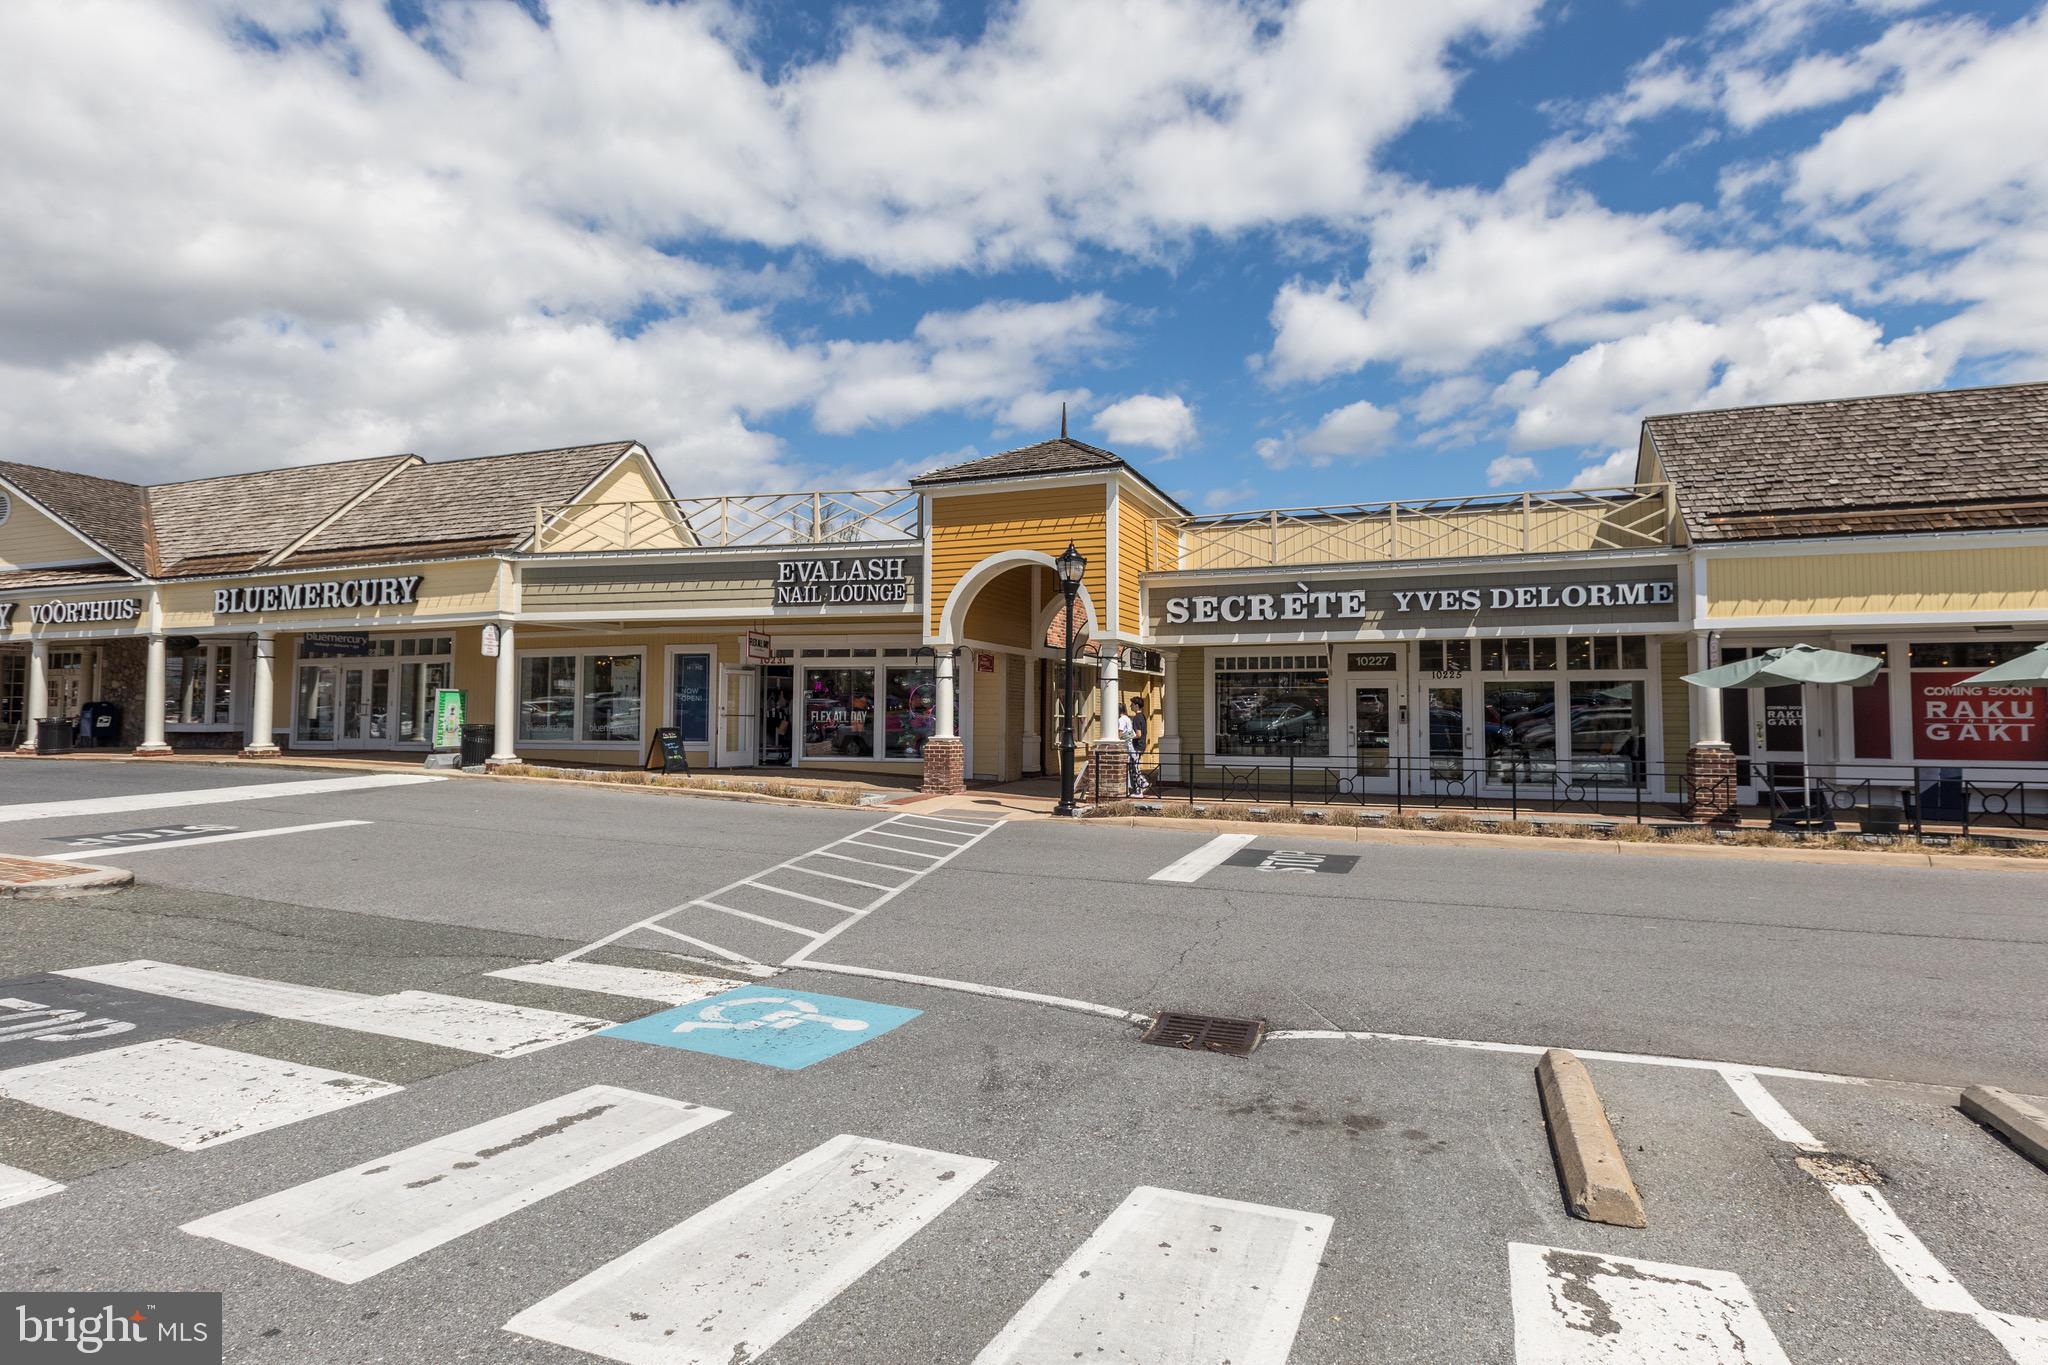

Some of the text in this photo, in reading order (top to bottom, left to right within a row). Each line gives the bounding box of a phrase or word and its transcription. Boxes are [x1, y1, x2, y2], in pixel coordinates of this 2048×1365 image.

[777, 558, 905, 583] EVALASH
[214, 575, 419, 614] BLUEMERCURY
[777, 583, 906, 604] NAIL LOUNGE
[1166, 581, 1366, 624] SECRÈTE
[1393, 582, 1674, 612] YVES DELORME
[305, 631, 368, 646] bluemercury
[1356, 656, 1389, 666] 10227
[1431, 670, 1463, 680] 10225
[1923, 686, 2033, 696] COMING SOON
[811, 711, 868, 722] FLEX ALL DAY
[1925, 701, 2034, 719] RAKU
[1926, 723, 2030, 742] GAKI
